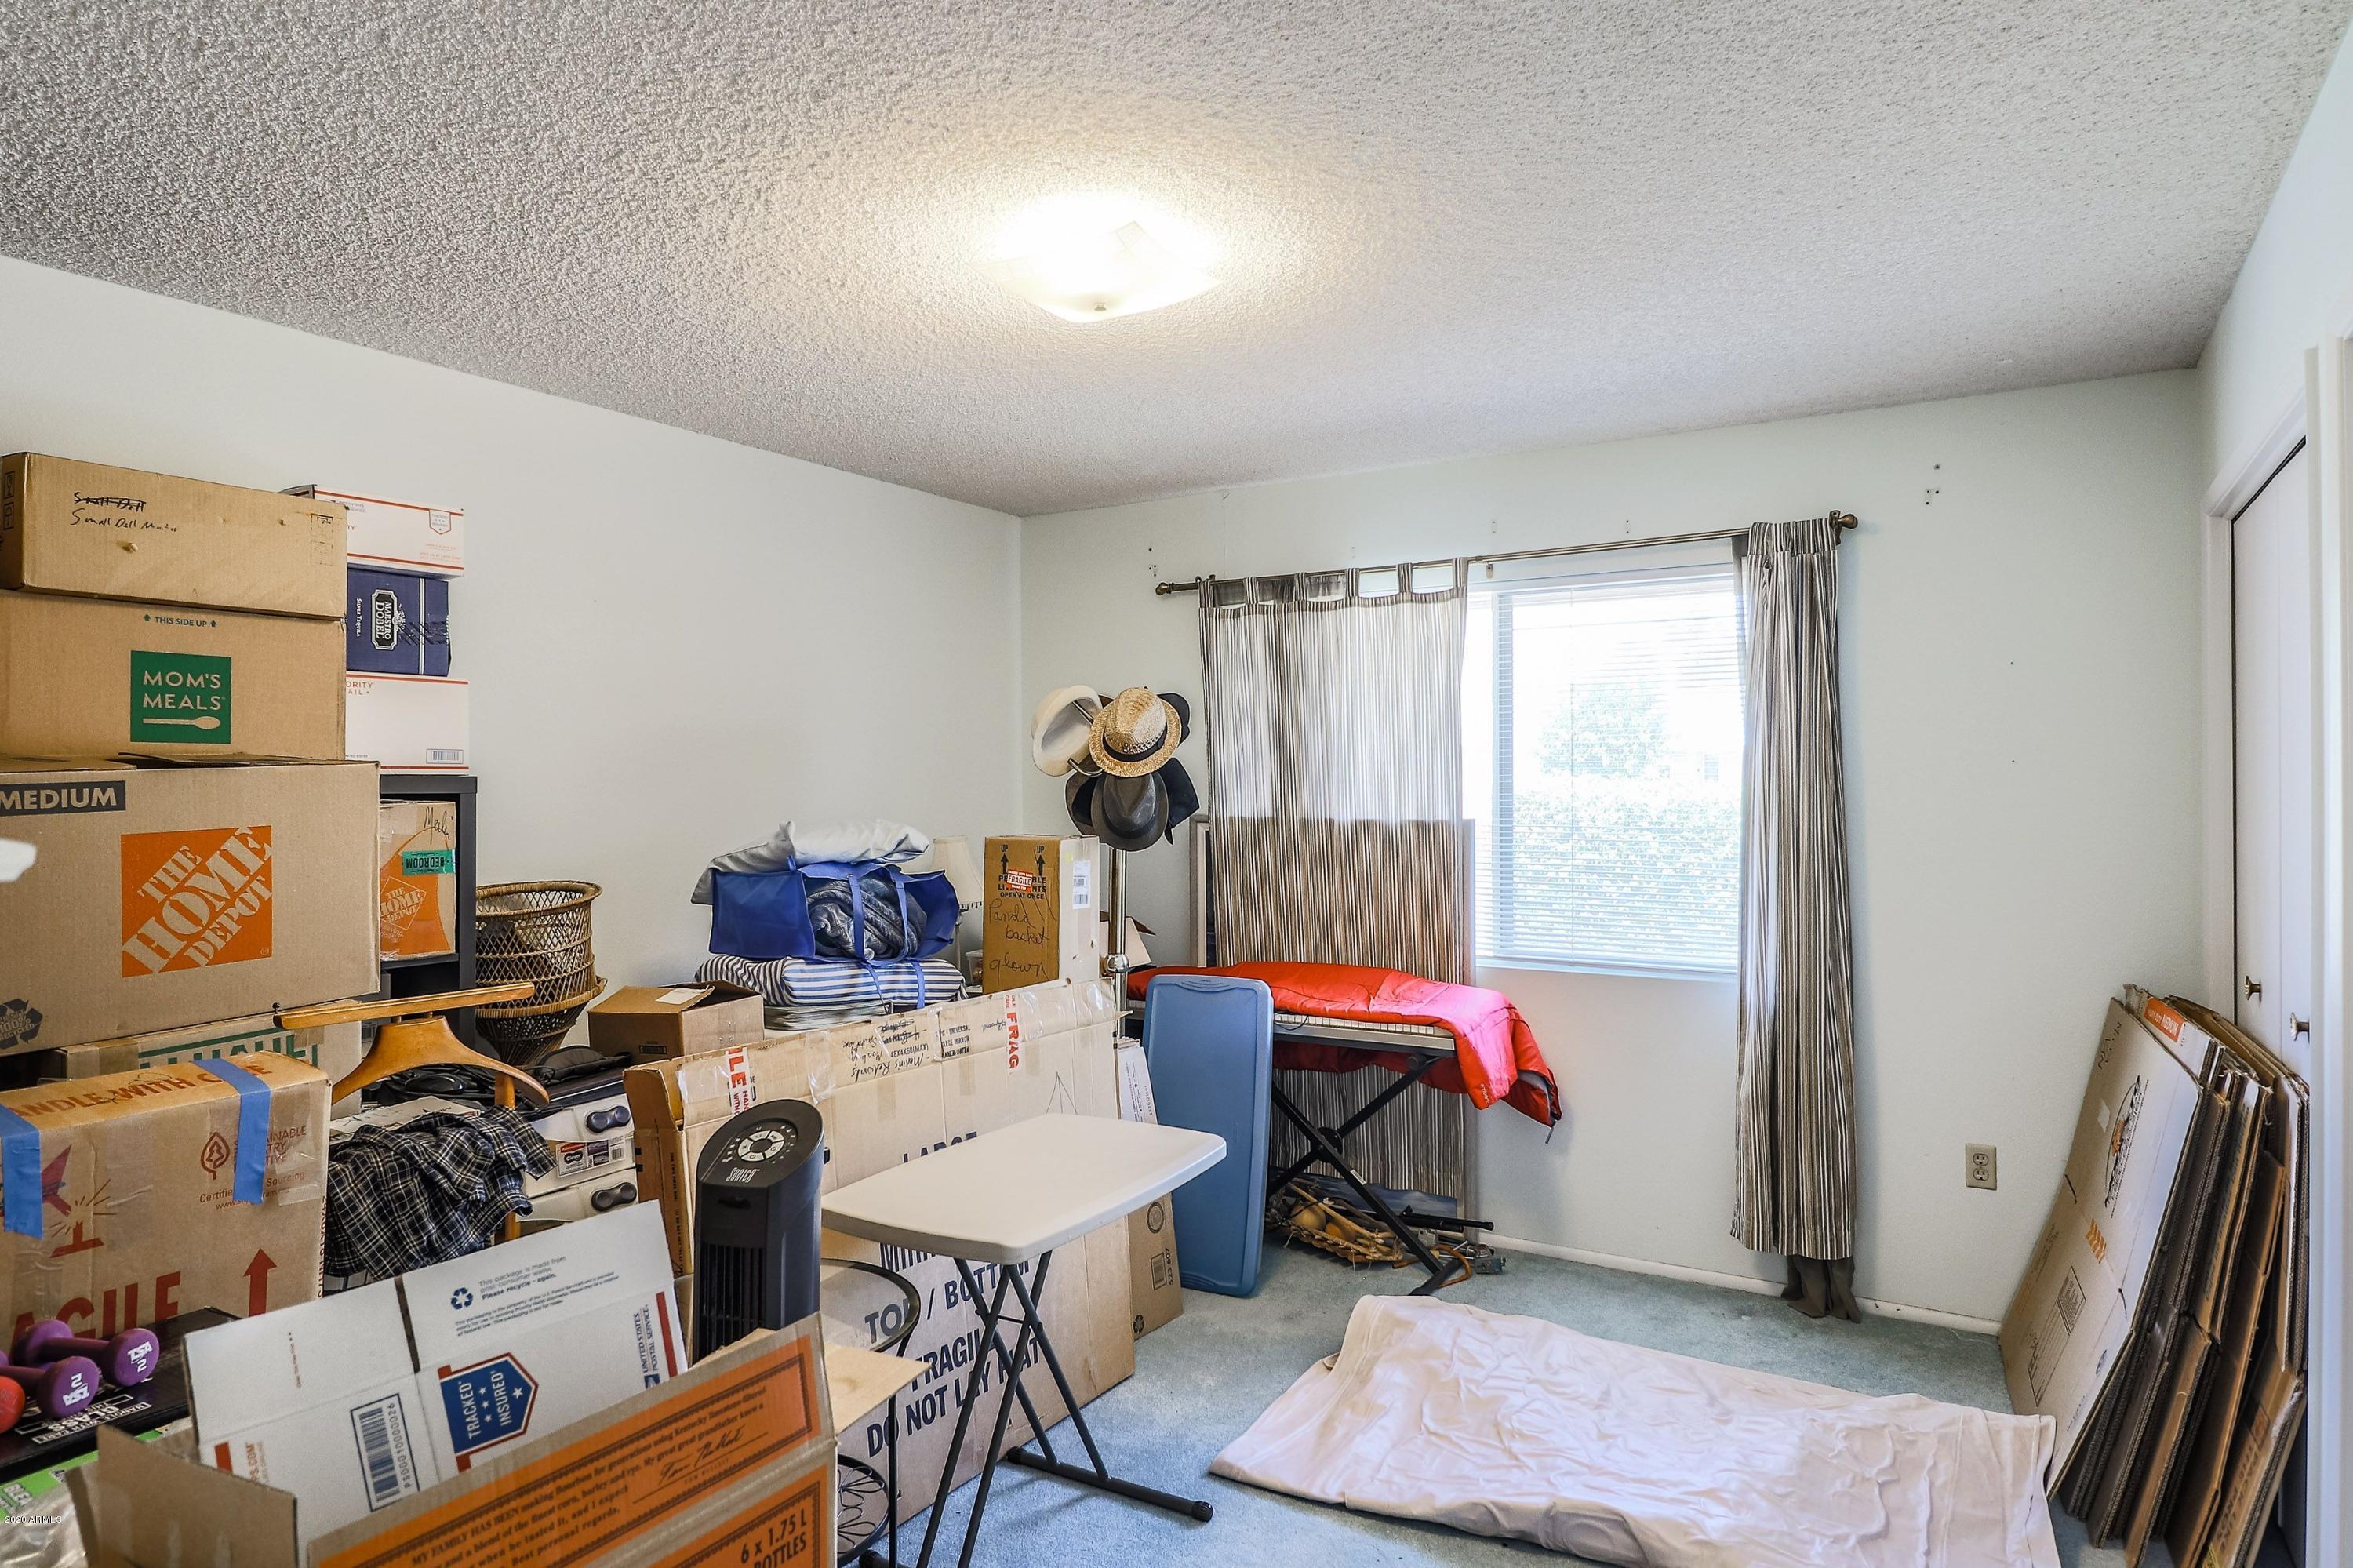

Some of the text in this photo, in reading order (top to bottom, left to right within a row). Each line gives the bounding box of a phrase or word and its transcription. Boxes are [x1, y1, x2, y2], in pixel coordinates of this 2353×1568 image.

[70, 508, 111, 526] Small
[384, 601, 392, 640] MAESTRO
[143, 671, 221, 689] MOM'S
[143, 693, 221, 711] MEALS
[0, 787, 117, 810] MEDIUM
[406, 856, 445, 869] BEDROOM
[1001, 844, 1009, 853] UP
[1037, 845, 1045, 854] UP
[136, 845, 202, 904] THE
[998, 875, 1047, 884] PEBLE
[1008, 875, 1032, 886] FRAGILE
[122, 826, 273, 974] HOME
[183, 875, 273, 967] DEPOT
[9, 1064, 273, 1118] ANDLE WITH CE
[199, 1188, 233, 1204] Certifie
[266, 1172, 305, 1188] Sourcing
[634, 1313, 649, 1373] UNITED STATES
[643, 1306, 659, 1372] POSTAL SERVICE
[71, 1373, 82, 1388] 2
[136, 1358, 147, 1373] 2
[459, 1381, 482, 1439] TRACKED
[491, 1371, 513, 1427] INSURED
[867, 1414, 900, 1458] DO
[905, 1384, 948, 1436] NOT
[954, 1361, 991, 1410] LY
[47, 1405, 119, 1432] GLASS
[412, 1551, 428, 1565] MY
[432, 1531, 468, 1557] FAMILY
[471, 1519, 492, 1537] HAS
[493, 1506, 519, 1526] BEEN
[740, 1508, 807, 1564] 6 x 1.75 L
